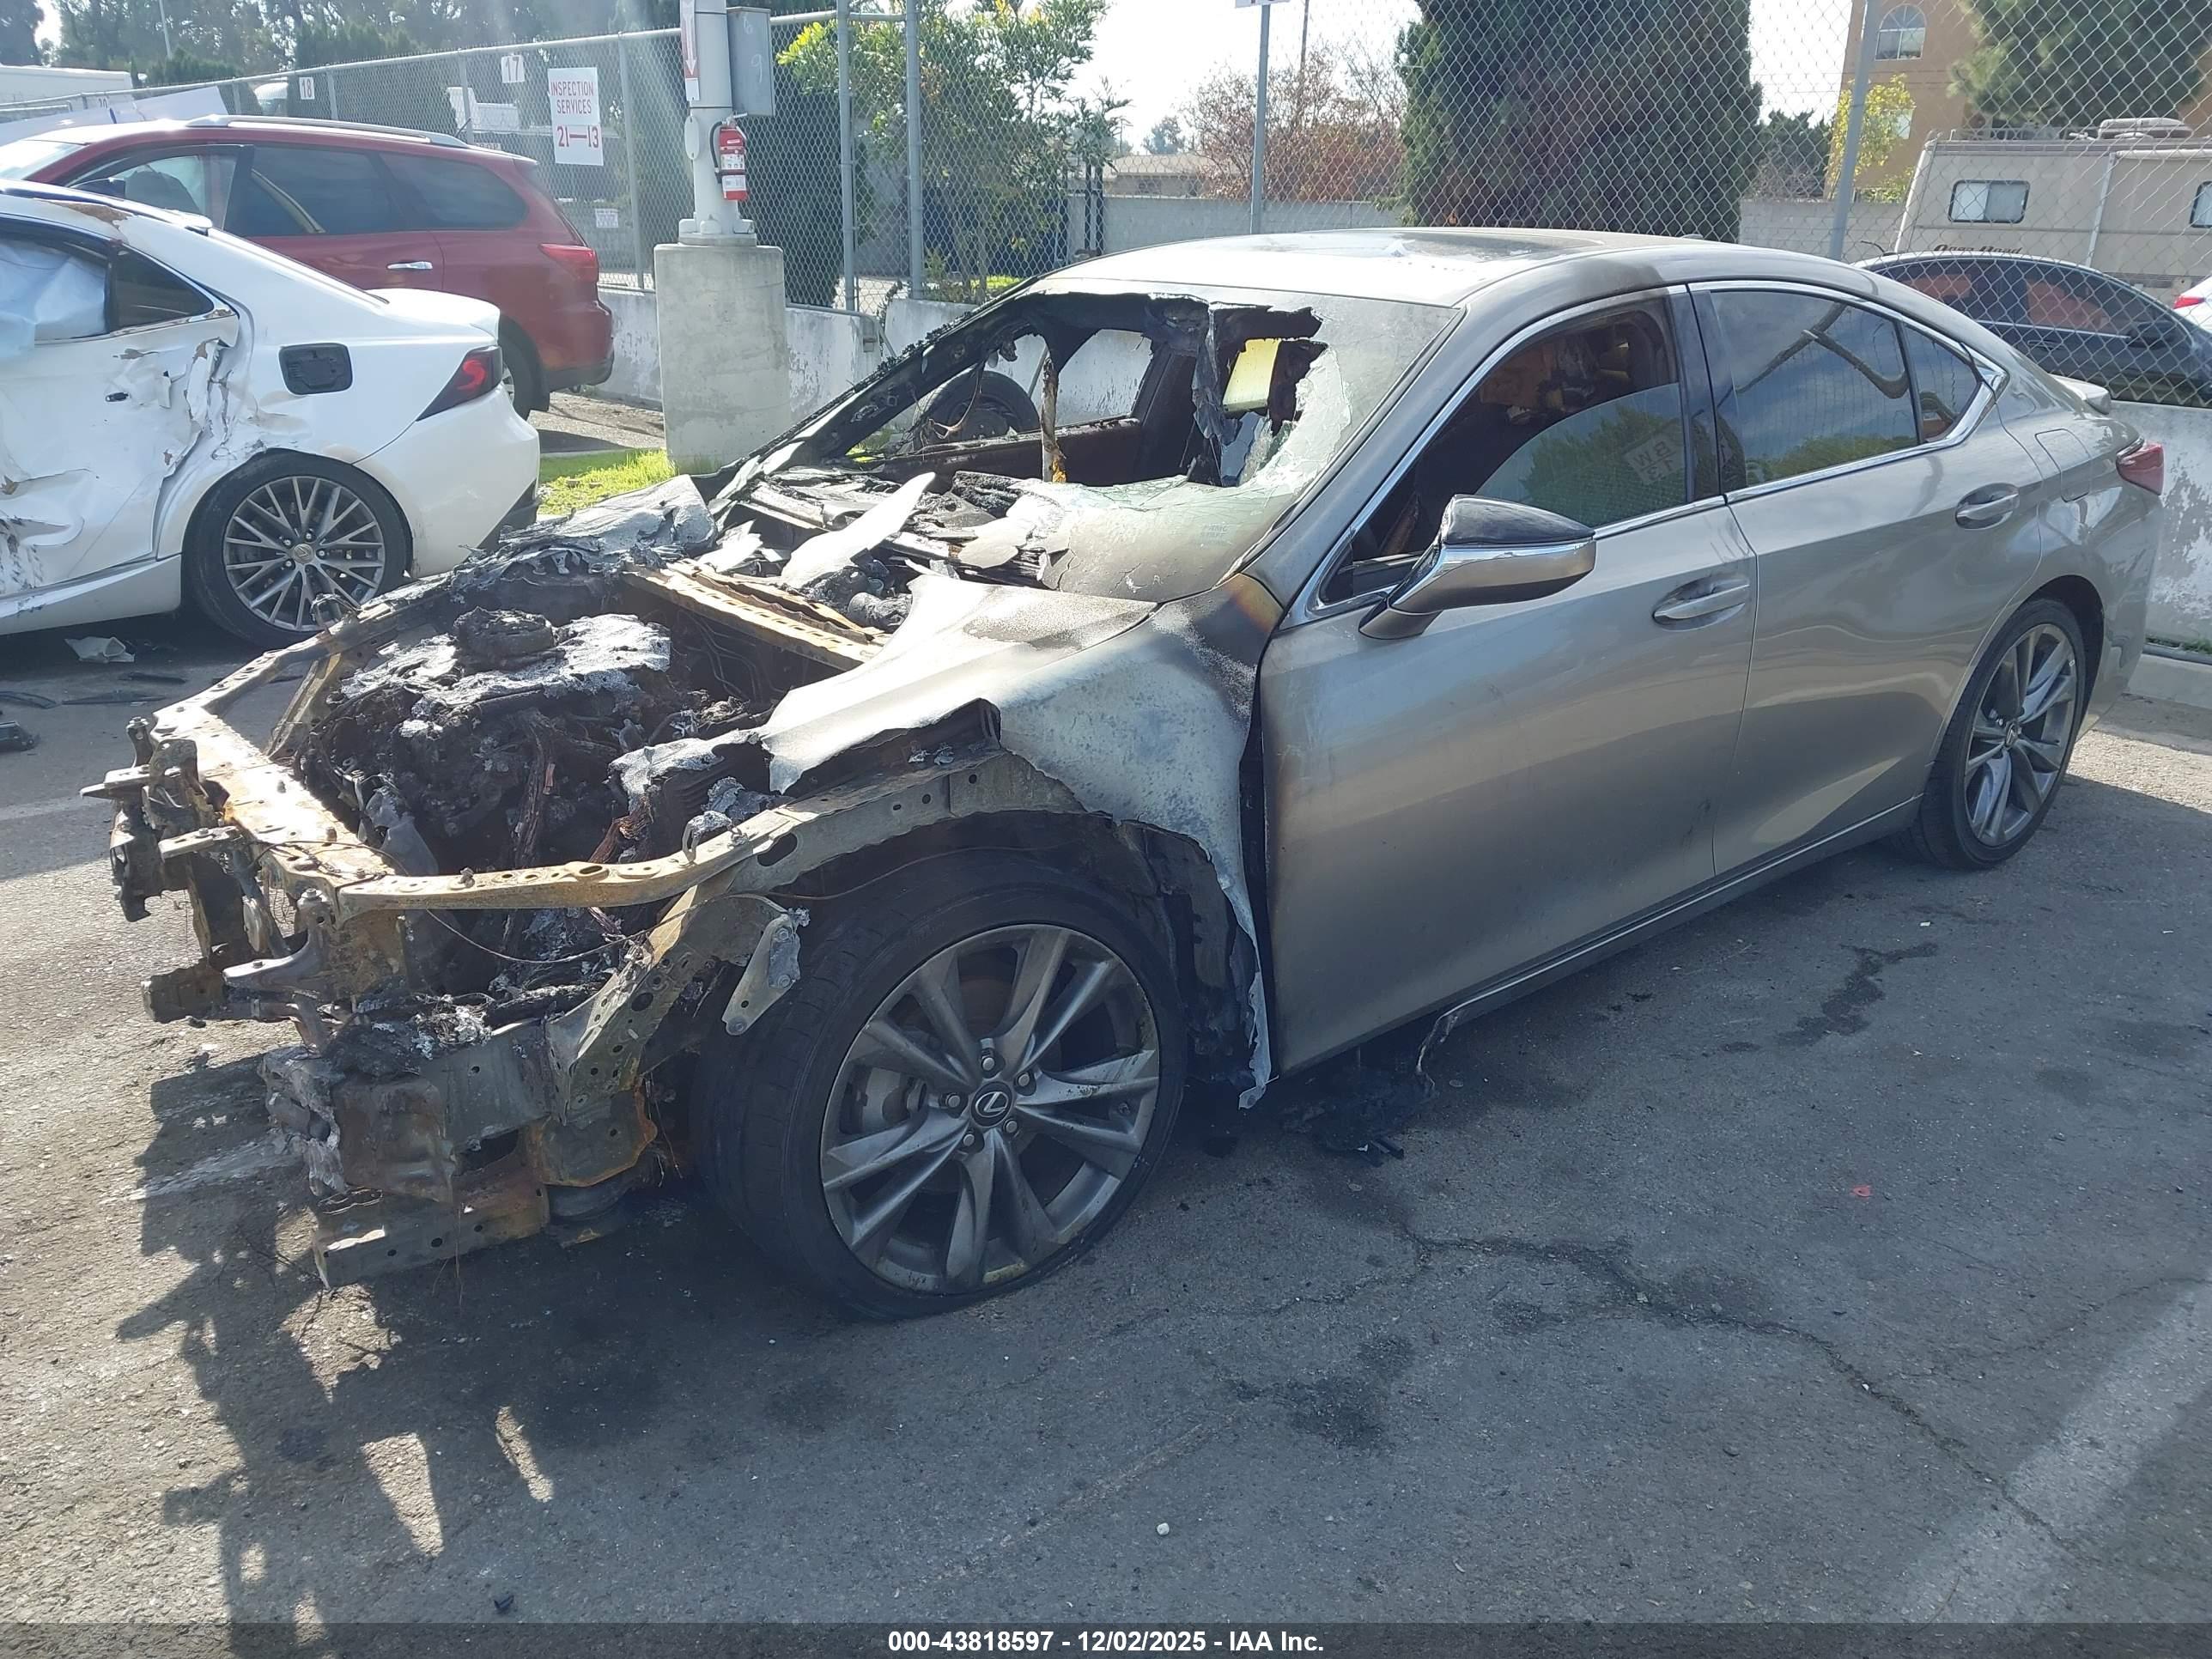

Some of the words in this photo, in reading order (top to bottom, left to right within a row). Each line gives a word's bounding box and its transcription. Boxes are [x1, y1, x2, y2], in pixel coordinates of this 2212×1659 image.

[505, 56, 520, 82] 17
[301, 78, 313, 98] 18
[550, 81, 594, 96] INSPECTION
[556, 99, 592, 114] SERVICES
